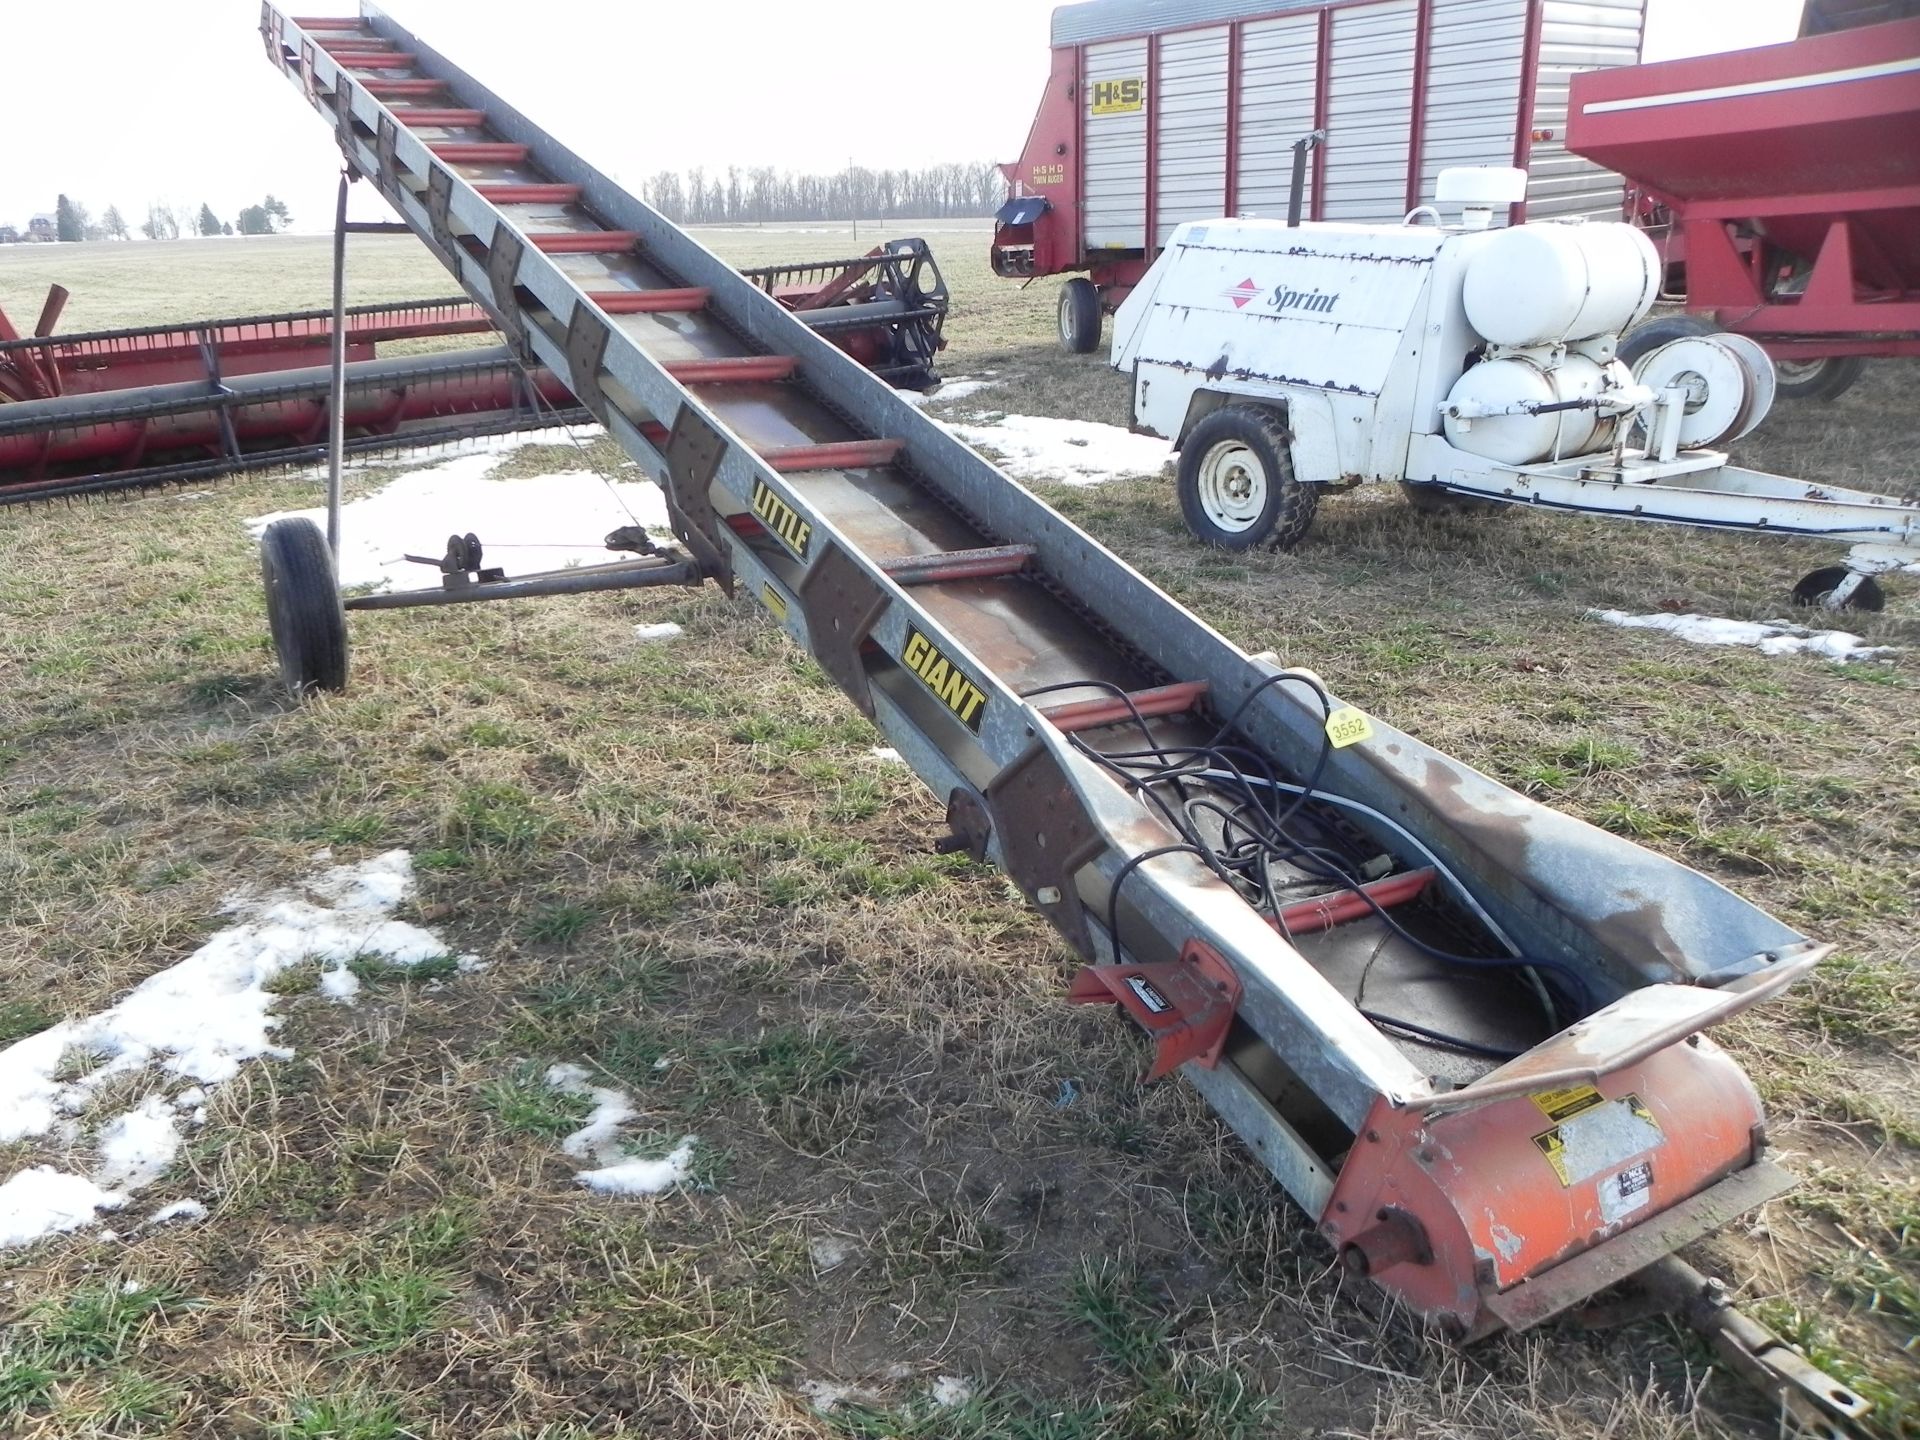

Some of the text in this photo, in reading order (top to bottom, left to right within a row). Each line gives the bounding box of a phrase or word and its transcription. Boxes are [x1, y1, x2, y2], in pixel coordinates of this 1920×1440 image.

[1095, 80, 1139, 106] H&S
[1267, 284, 1340, 313] Sprint
[754, 481, 811, 554] LITTLE
[903, 632, 987, 722] GIANT
[1333, 718, 1365, 739] 3552
